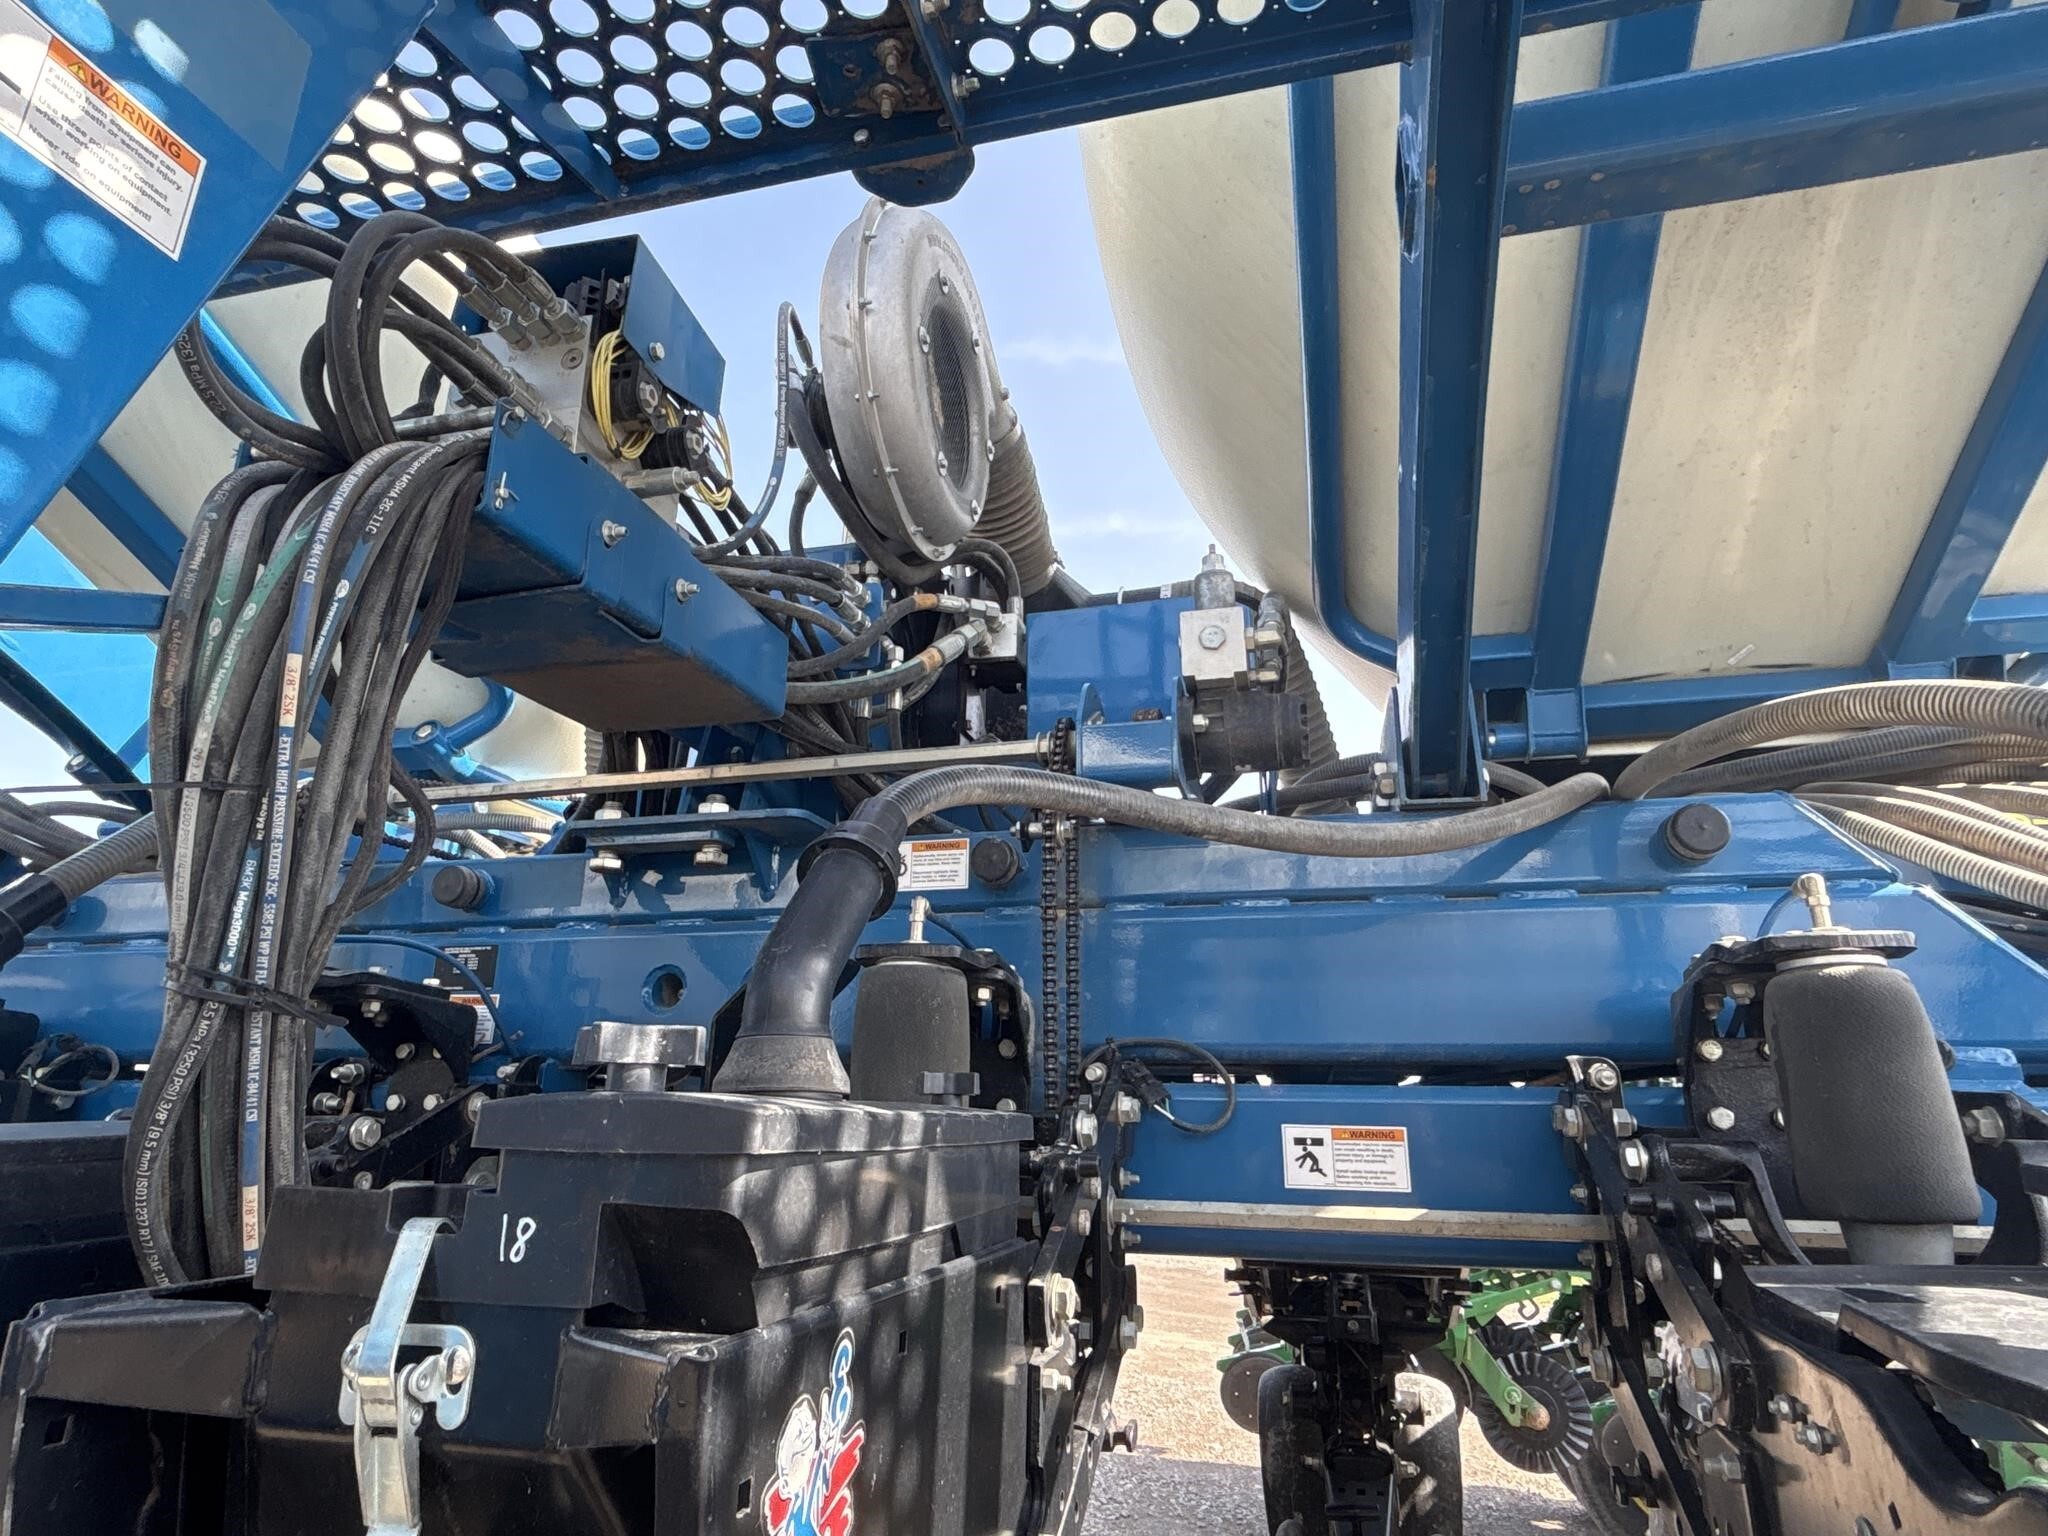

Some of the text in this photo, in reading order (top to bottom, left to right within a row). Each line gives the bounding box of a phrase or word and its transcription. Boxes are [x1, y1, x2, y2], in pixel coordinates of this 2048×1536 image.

[48, 66, 177, 175] Falling from equipment can
[90, 72, 182, 159] WARNING
[45, 77, 184, 193] cause death or serious injury,
[32, 103, 173, 217] when working on equipment.
[38, 95, 168, 202] Use three points of contact
[29, 123, 60, 151] Never
[61, 150, 81, 168] ride
[83, 167, 97, 180] on
[99, 179, 153, 222] equipment!
[178, 329, 197, 362] (325
[190, 364, 209, 392] MPa
[406, 445, 443, 476] Resistant
[331, 473, 359, 512] RESISTANT
[387, 473, 412, 498] MSHA
[319, 509, 338, 532] MSHA
[365, 497, 394, 535] 2G-11C
[303, 568, 316, 584] CSI
[282, 665, 298, 717] 3/8" 2SK
[275, 768, 289, 794] HIGH
[925, 841, 961, 850] WARNING
[227, 859, 257, 958] 6M3K Mega3000™
[262, 902, 276, 925] 5585
[260, 925, 273, 939] PSI
[257, 939, 271, 956] WP
[256, 955, 269, 968] HT
[202, 1000, 219, 1019] 2.5
[192, 1018, 211, 1042] MPa
[175, 1042, 202, 1077] (3250
[248, 1046, 261, 1071] MSHA
[163, 1075, 185, 1101] PSI)
[154, 1100, 173, 1126] 3/8"
[245, 1107, 258, 1122] CSI
[144, 1125, 164, 1149] (9.5
[1348, 1130, 1396, 1140] WARNING
[136, 1150, 151, 1176] mm)
[134, 1175, 150, 1227] ISO11237
[138, 1226, 154, 1248] R17
[244, 1222, 257, 1242] 2SK
[499, 1212, 537, 1264] 18
[146, 1253, 163, 1275] SAE
